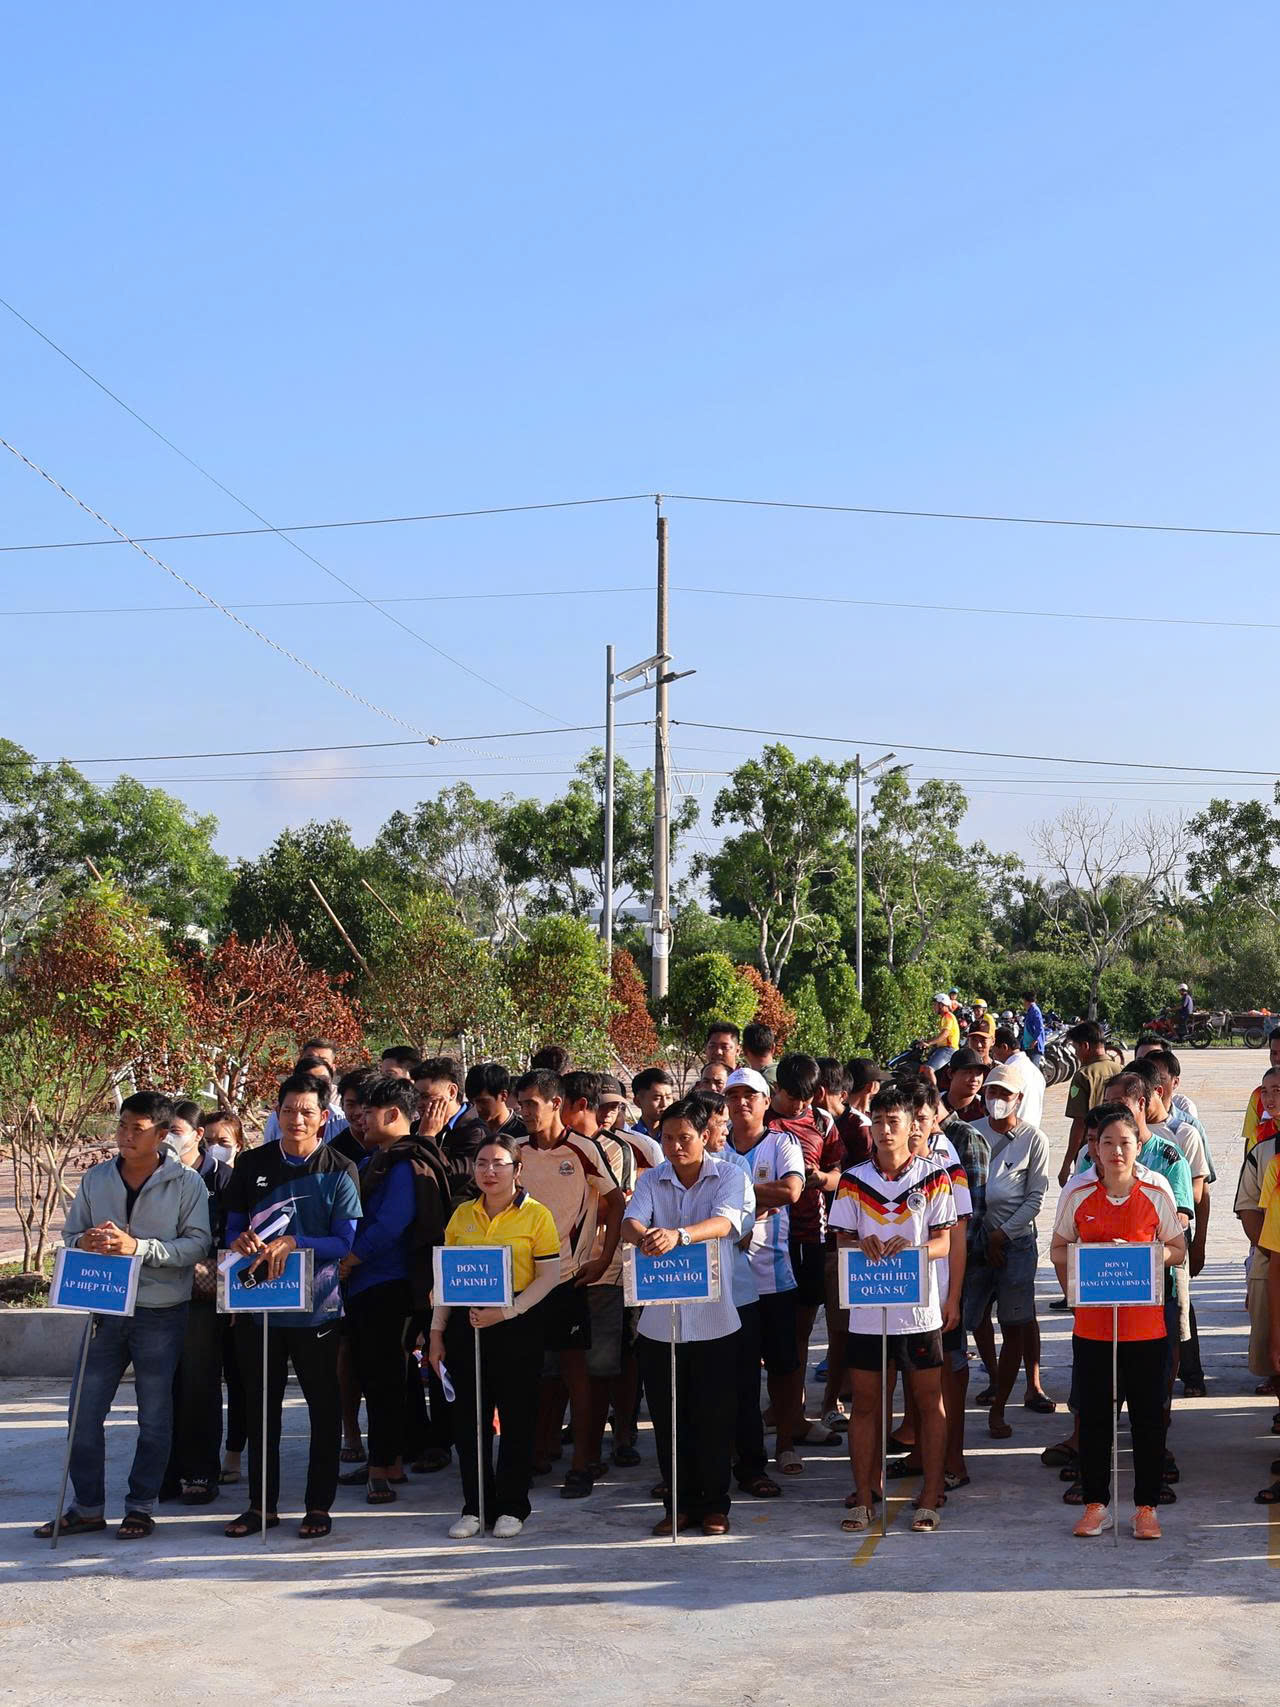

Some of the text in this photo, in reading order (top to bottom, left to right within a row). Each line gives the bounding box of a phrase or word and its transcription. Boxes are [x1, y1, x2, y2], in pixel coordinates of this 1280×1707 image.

[653, 1259, 690, 1269] ĐƠN VỊ
[891, 1258, 902, 1268] VỊ
[457, 1264, 489, 1274] ĐƠN VỊ
[81, 1268, 112, 1281] ĐƠN VỊ
[683, 1271, 703, 1283] HỘI
[850, 1273, 872, 1282] BAN
[896, 1272, 918, 1280] HUY
[77, 1280, 99, 1292] HIỆP
[463, 1278, 487, 1286] KINH
[489, 1278, 498, 1286] 17
[861, 1284, 909, 1297] QUÂN SỰ
